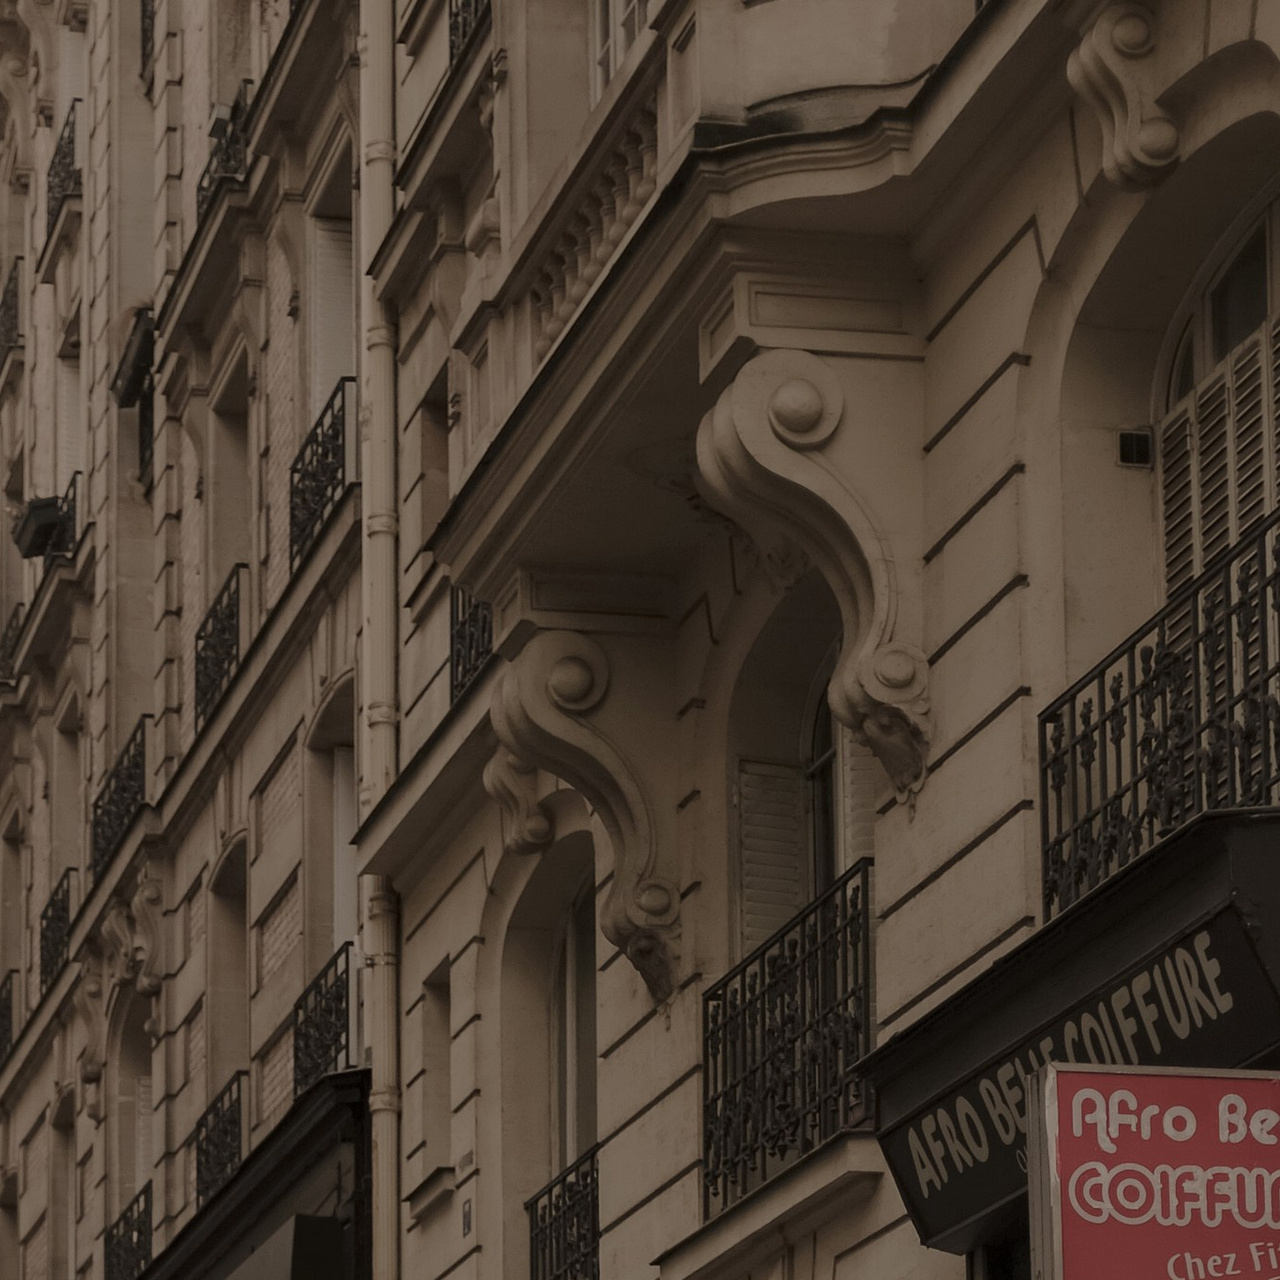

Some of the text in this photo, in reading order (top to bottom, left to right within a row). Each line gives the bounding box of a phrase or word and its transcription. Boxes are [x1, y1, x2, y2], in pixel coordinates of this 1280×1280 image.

[907, 1095, 990, 1199] AFRO
[1063, 930, 1234, 1066] COIFFURE
[1072, 1087, 1198, 1154] Afro
